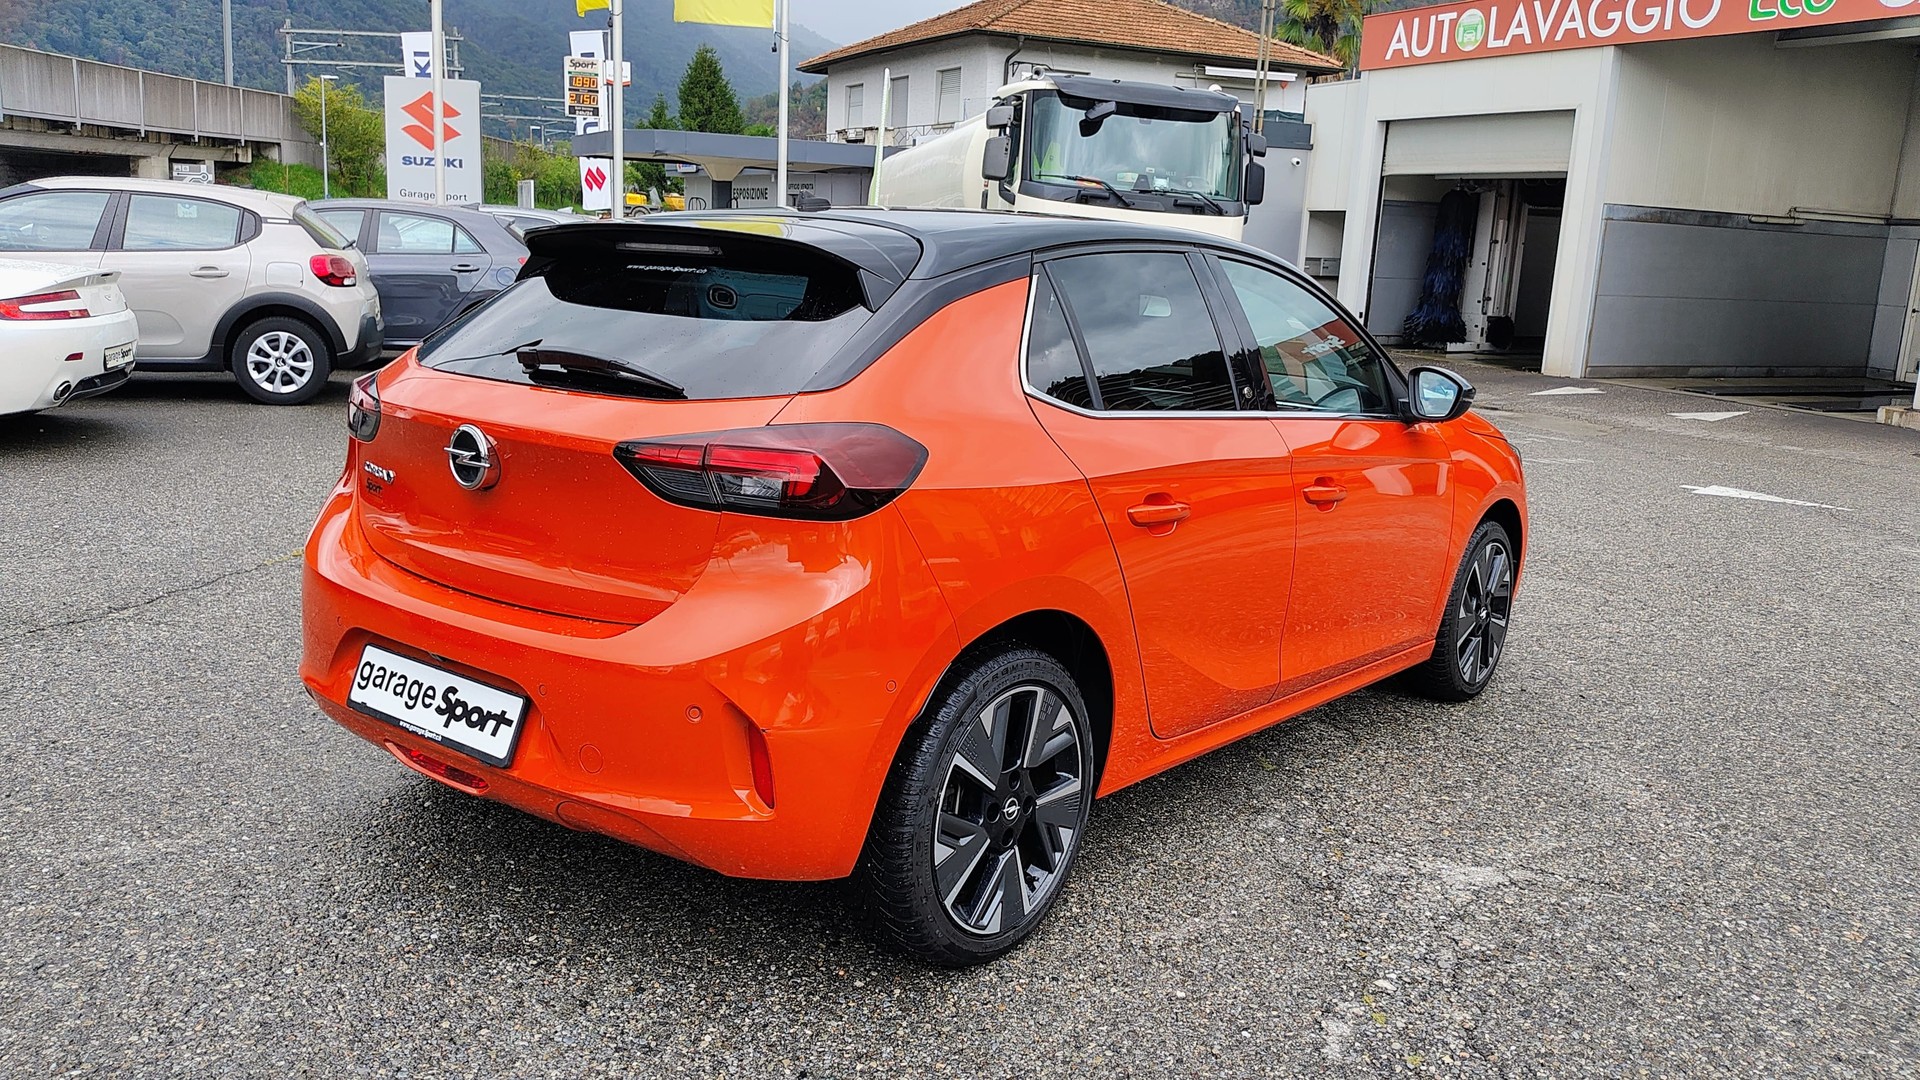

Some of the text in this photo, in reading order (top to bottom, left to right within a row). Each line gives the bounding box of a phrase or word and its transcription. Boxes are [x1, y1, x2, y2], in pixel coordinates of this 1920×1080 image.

[569, 59, 597, 70] Sport
[402, 155, 463, 169] SUZKI
[399, 189, 468, 202] Garage port
[733, 187, 769, 200] ESPOSIZIONE
[357, 660, 515, 738] garage Sport
